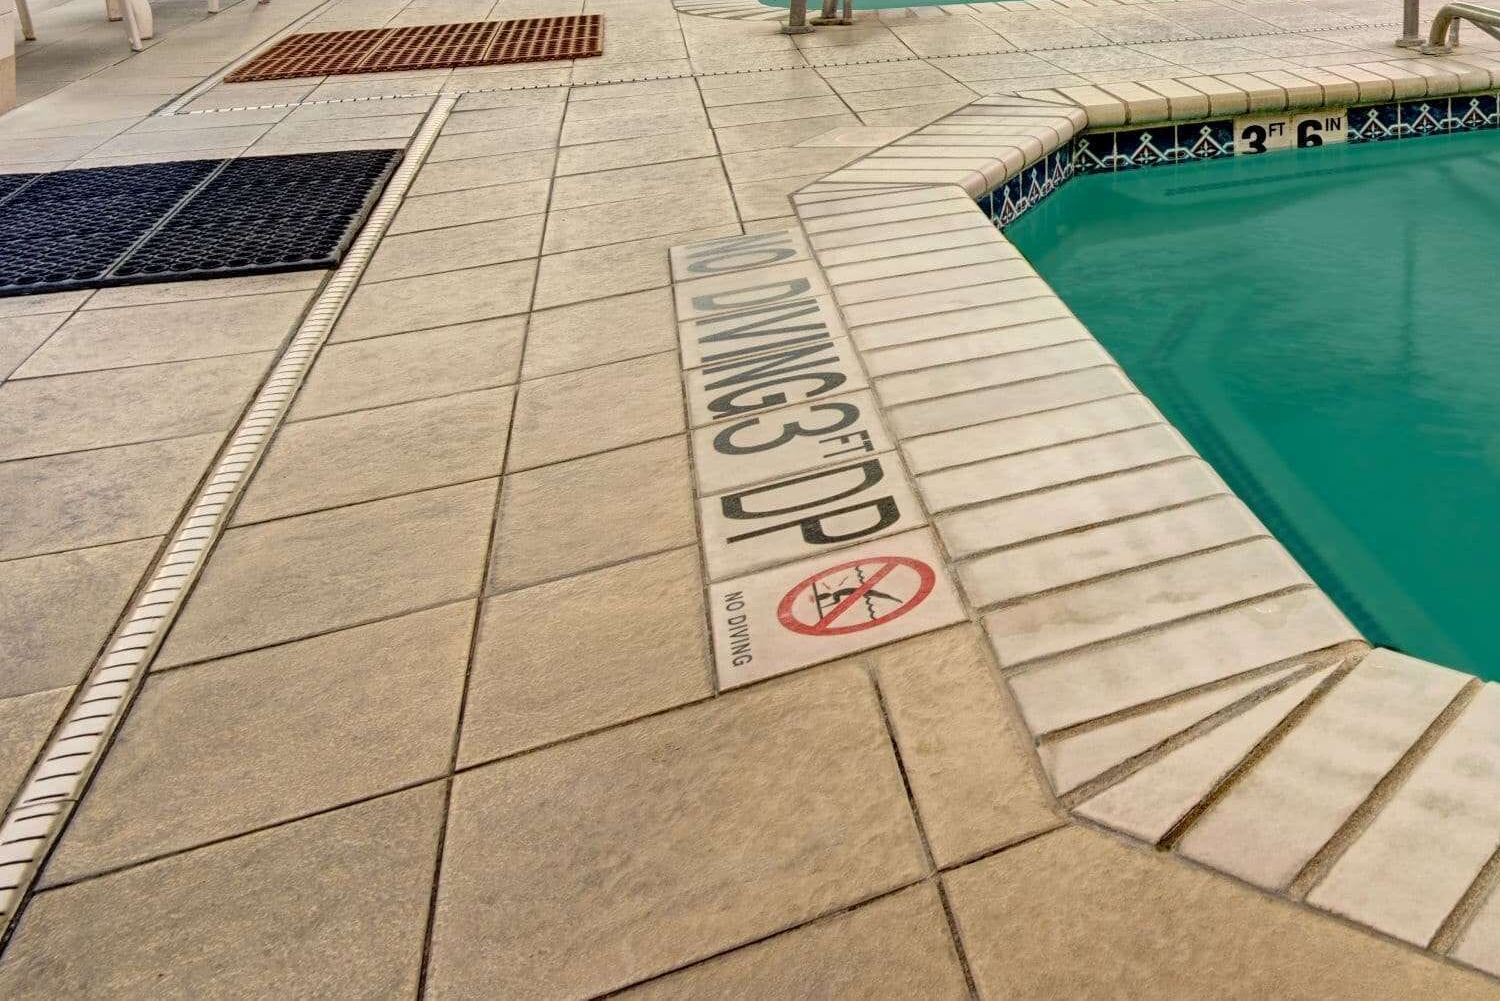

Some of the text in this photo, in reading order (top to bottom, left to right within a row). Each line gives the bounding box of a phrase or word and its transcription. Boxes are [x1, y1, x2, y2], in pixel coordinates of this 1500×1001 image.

[1241, 117, 1341, 154] 3 FT 6 IN
[685, 229, 901, 545] NO DIVING 3 FT DP
[724, 590, 753, 668] NO DIVING
